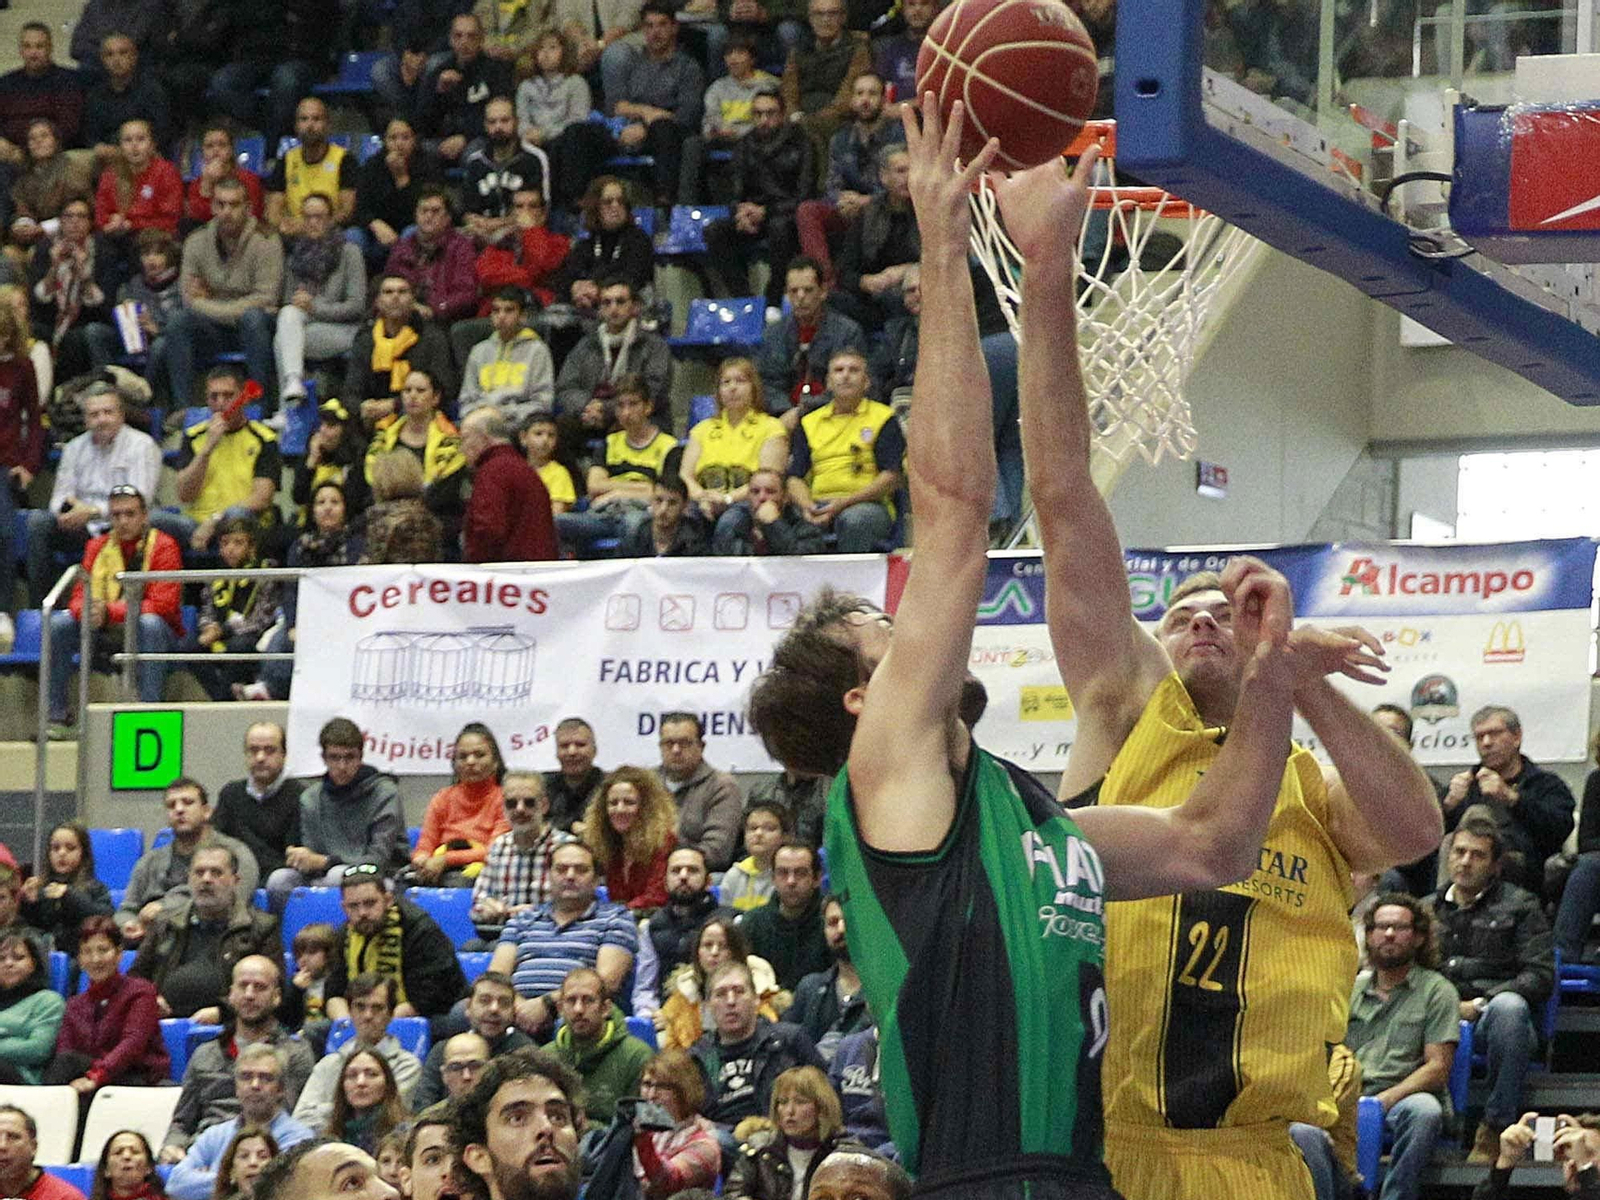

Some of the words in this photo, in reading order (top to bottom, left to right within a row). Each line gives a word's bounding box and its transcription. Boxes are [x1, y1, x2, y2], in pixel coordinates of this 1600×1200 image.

[1013, 561, 1044, 577] Cen
[1339, 557, 1534, 599] Alcampo
[348, 577, 550, 618] Cereales
[600, 658, 720, 684] FABRICA
[732, 660, 747, 683] Y
[135, 728, 163, 772] D
[1410, 727, 1471, 749] icios
[1178, 920, 1230, 992] 22
